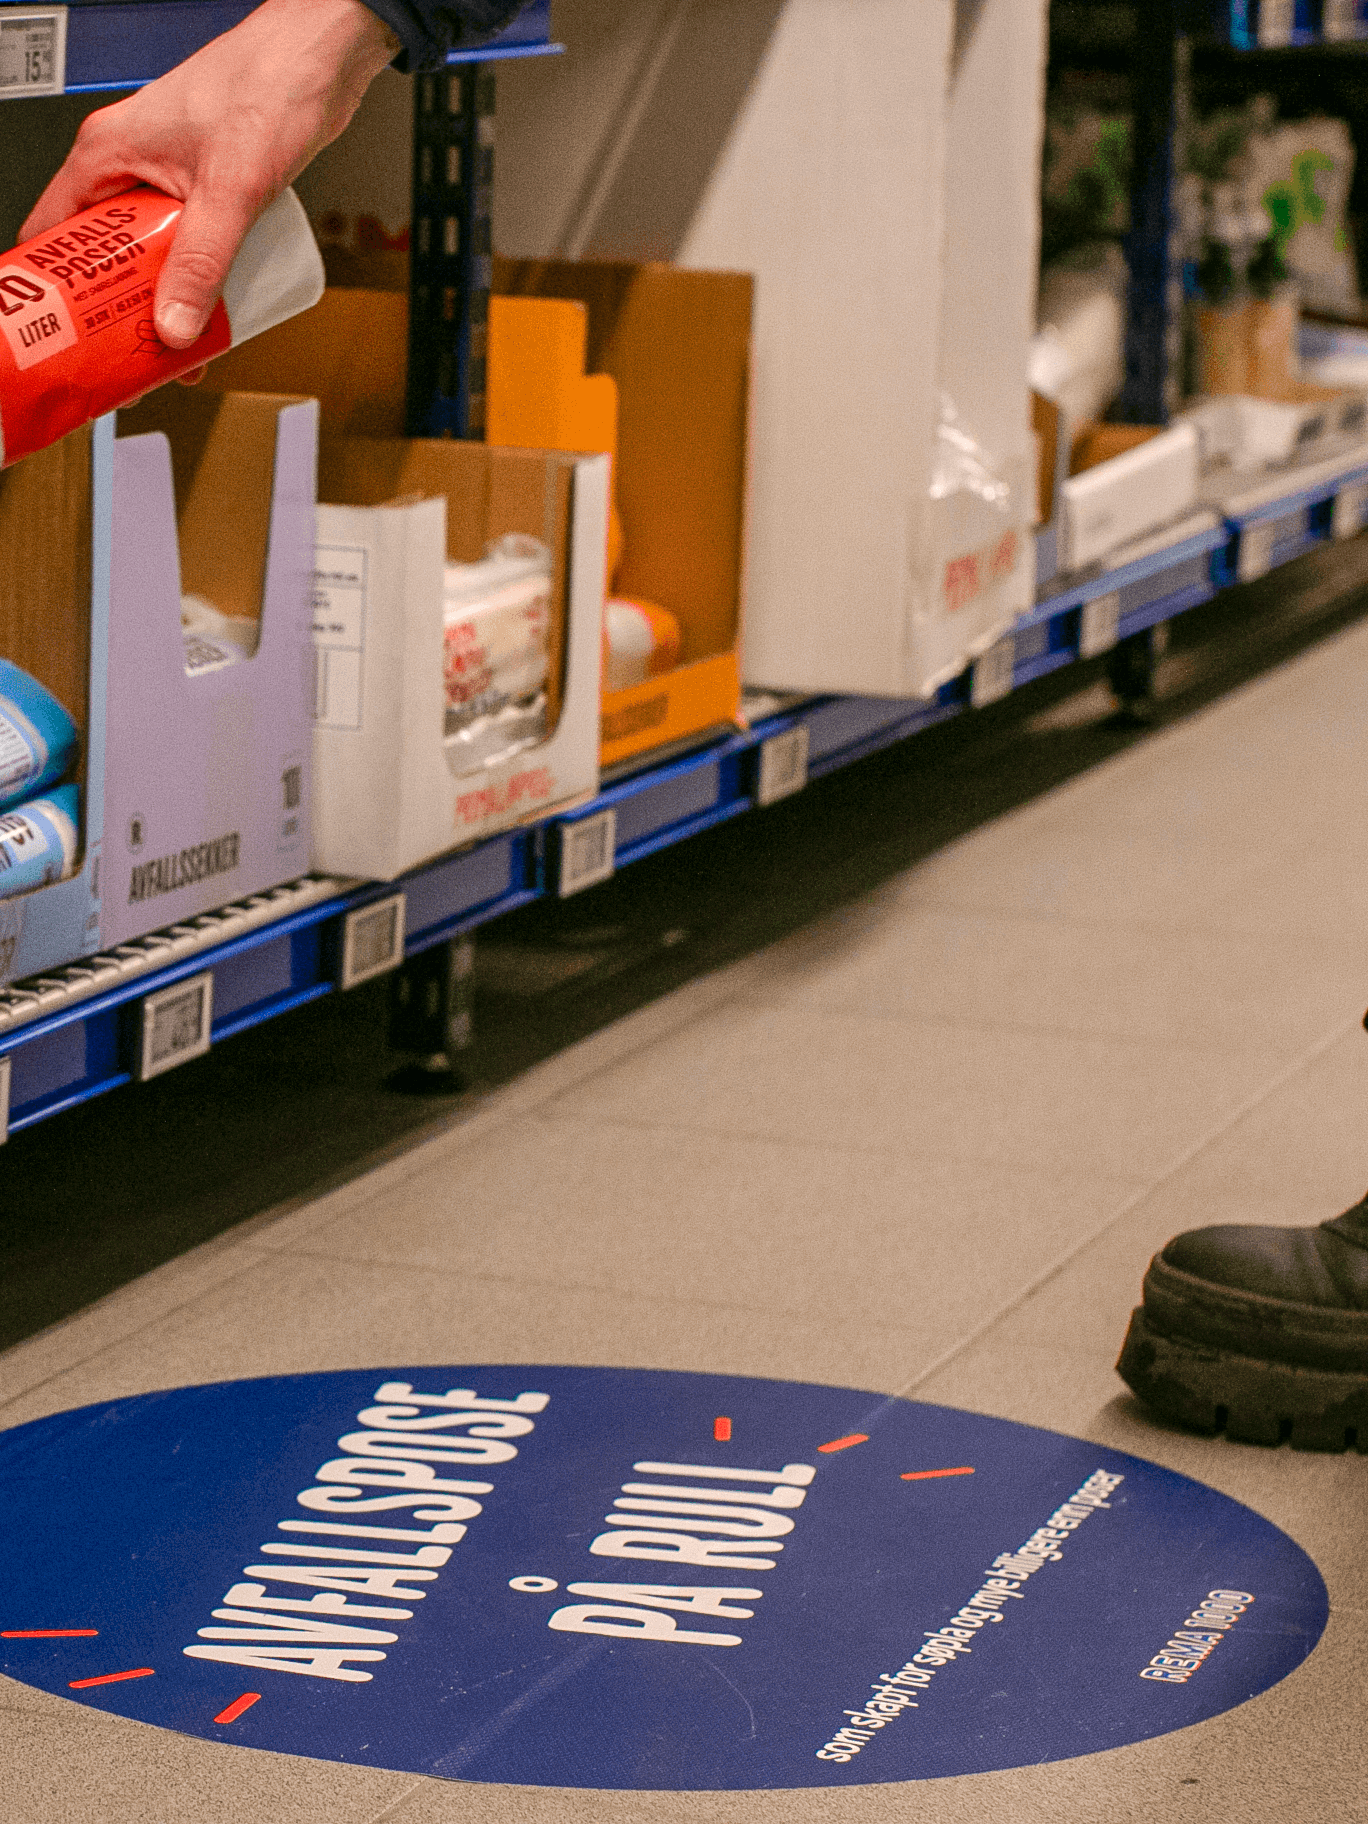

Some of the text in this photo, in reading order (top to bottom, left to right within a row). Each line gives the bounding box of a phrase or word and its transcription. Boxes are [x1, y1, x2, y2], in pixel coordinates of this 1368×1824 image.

[25, 51, 42, 82] 15
[24, 206, 137, 269] AVFALLS-
[49, 232, 146, 289] POSER
[18, 312, 62, 348] LITER
[182, 1381, 550, 1683] AVFALLSPOSE
[508, 1461, 816, 1646] PÅ RULL
[816, 1468, 1125, 1763] som skapt for søpla og mye billigere enn poser
[1140, 1589, 1255, 1683] REMA 1000
